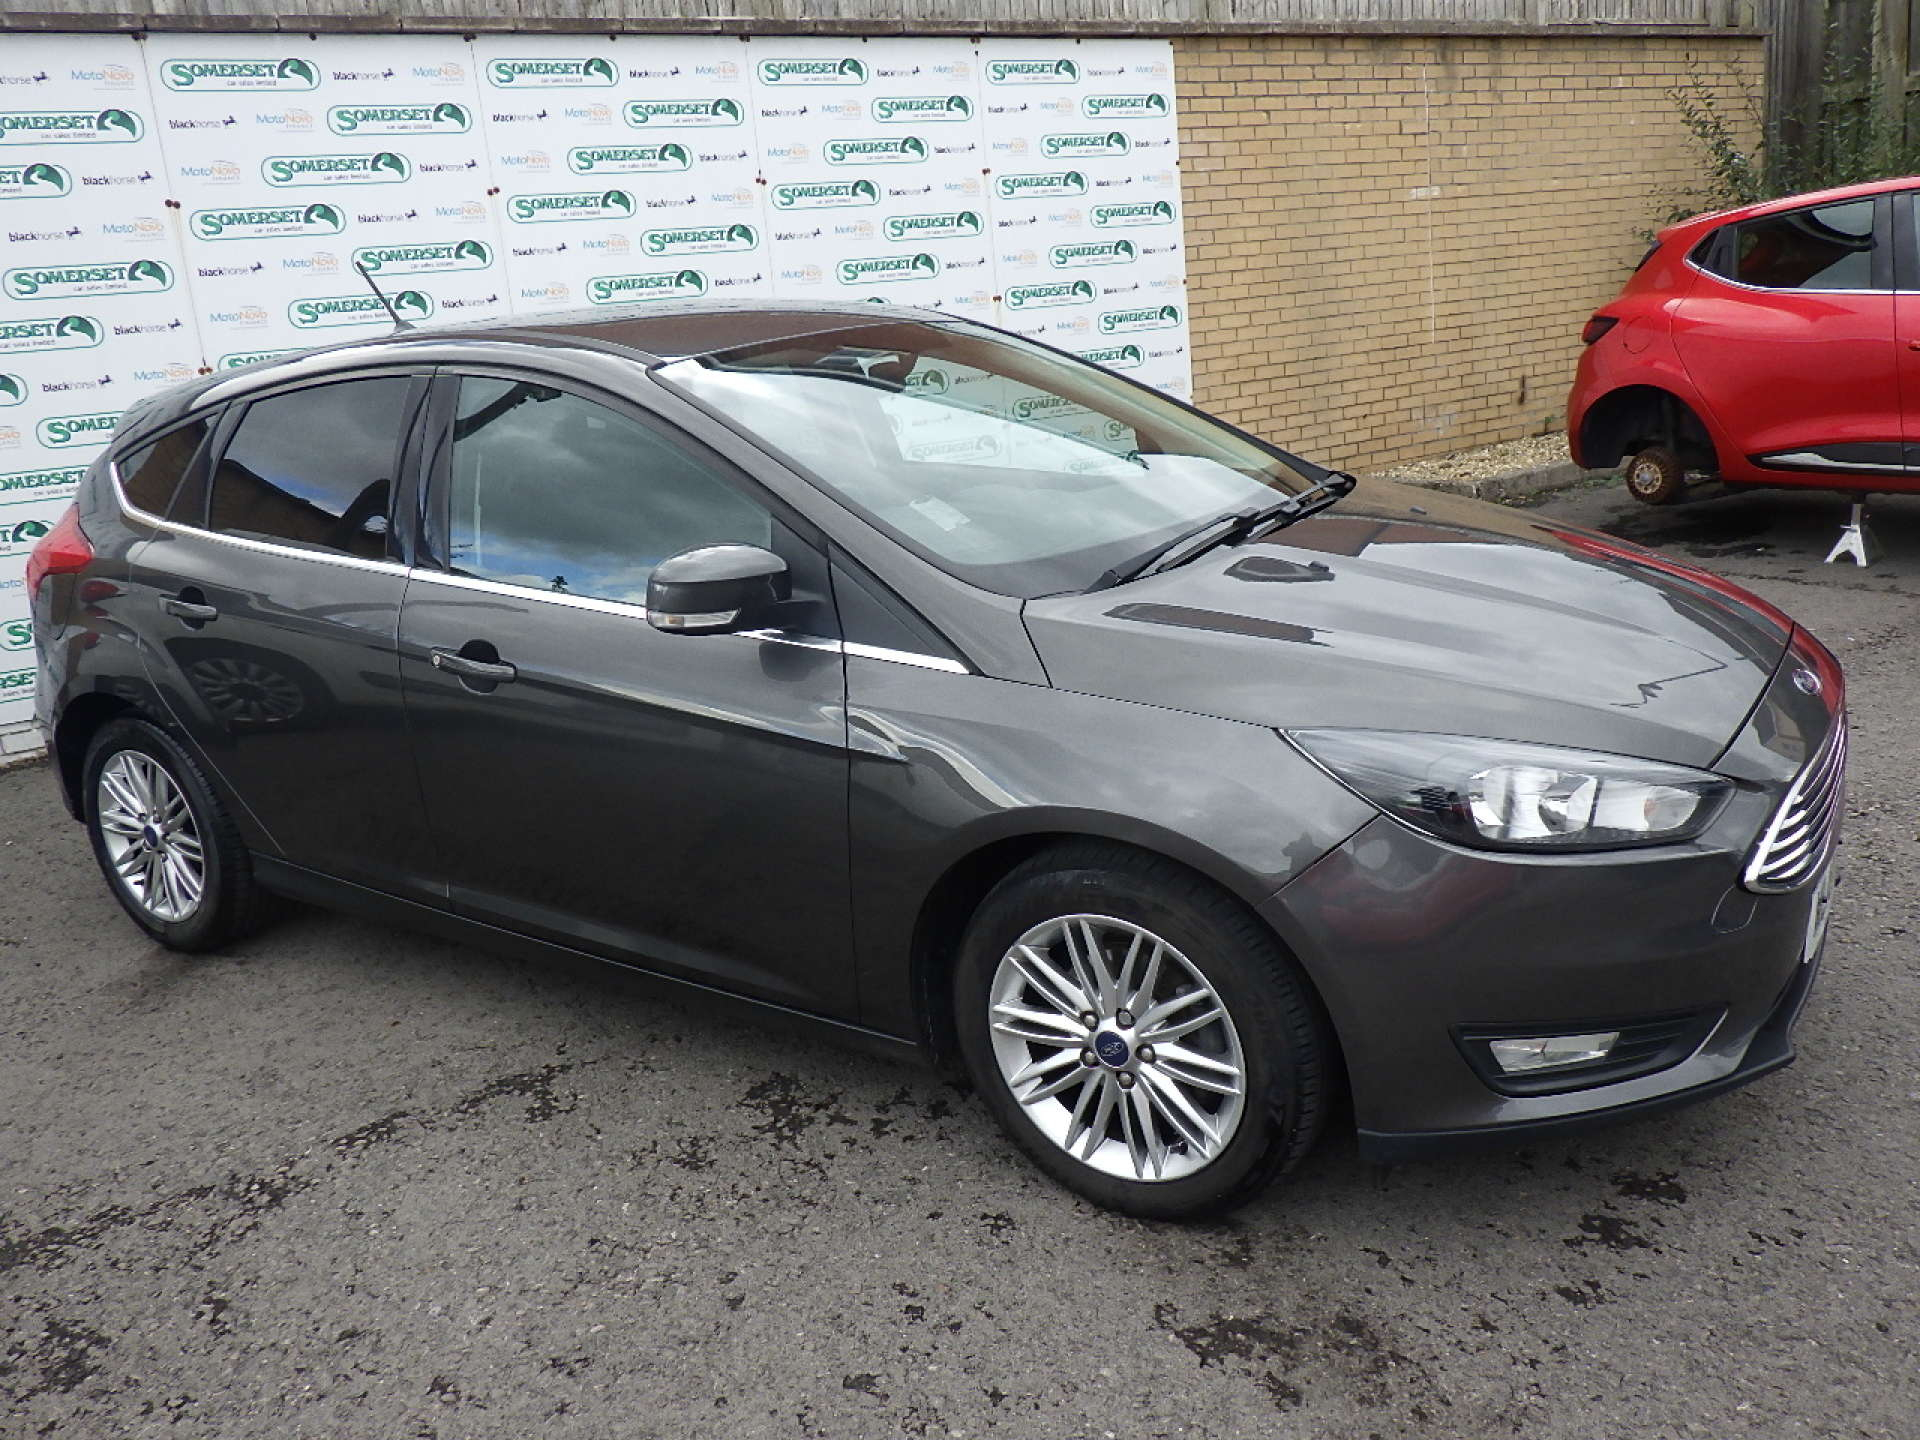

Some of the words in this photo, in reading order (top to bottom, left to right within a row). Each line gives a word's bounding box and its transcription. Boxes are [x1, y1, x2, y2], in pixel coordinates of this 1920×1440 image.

[171, 63, 276, 87] SOMERSET
[495, 62, 583, 83] SOMERSET
[765, 62, 838, 81] SOMERSET
[992, 63, 1055, 81] SOMERSET
[631, 104, 711, 123] SOMERSET
[878, 100, 945, 118] SOMERSET
[1088, 99, 1145, 115] SOMERSET
[336, 109, 432, 130] SOMERSET
[831, 143, 900, 161] SOMERSET
[1046, 137, 1105, 154] SOMERSET
[575, 150, 657, 170] SOMERSET
[271, 159, 370, 182] SOMERSET
[1002, 174, 1062, 196] SOMERSET
[778, 185, 850, 206] SOMERSET
[515, 196, 600, 218] SOMERSET
[1096, 207, 1151, 224] SOMERSET
[201, 211, 303, 236] SOMERSET
[890, 216, 955, 237] SOMERSET
[649, 229, 726, 252] SOMERSET
[362, 247, 455, 271] SOMERSET
[1056, 245, 1114, 265] SOMERSET
[14, 267, 126, 295] SOMERSET
[842, 261, 911, 281] SOMERSET
[594, 277, 674, 300] SOMERSET
[1011, 287, 1071, 306] SOMERSET
[1104, 313, 1158, 332] SOMERSET
